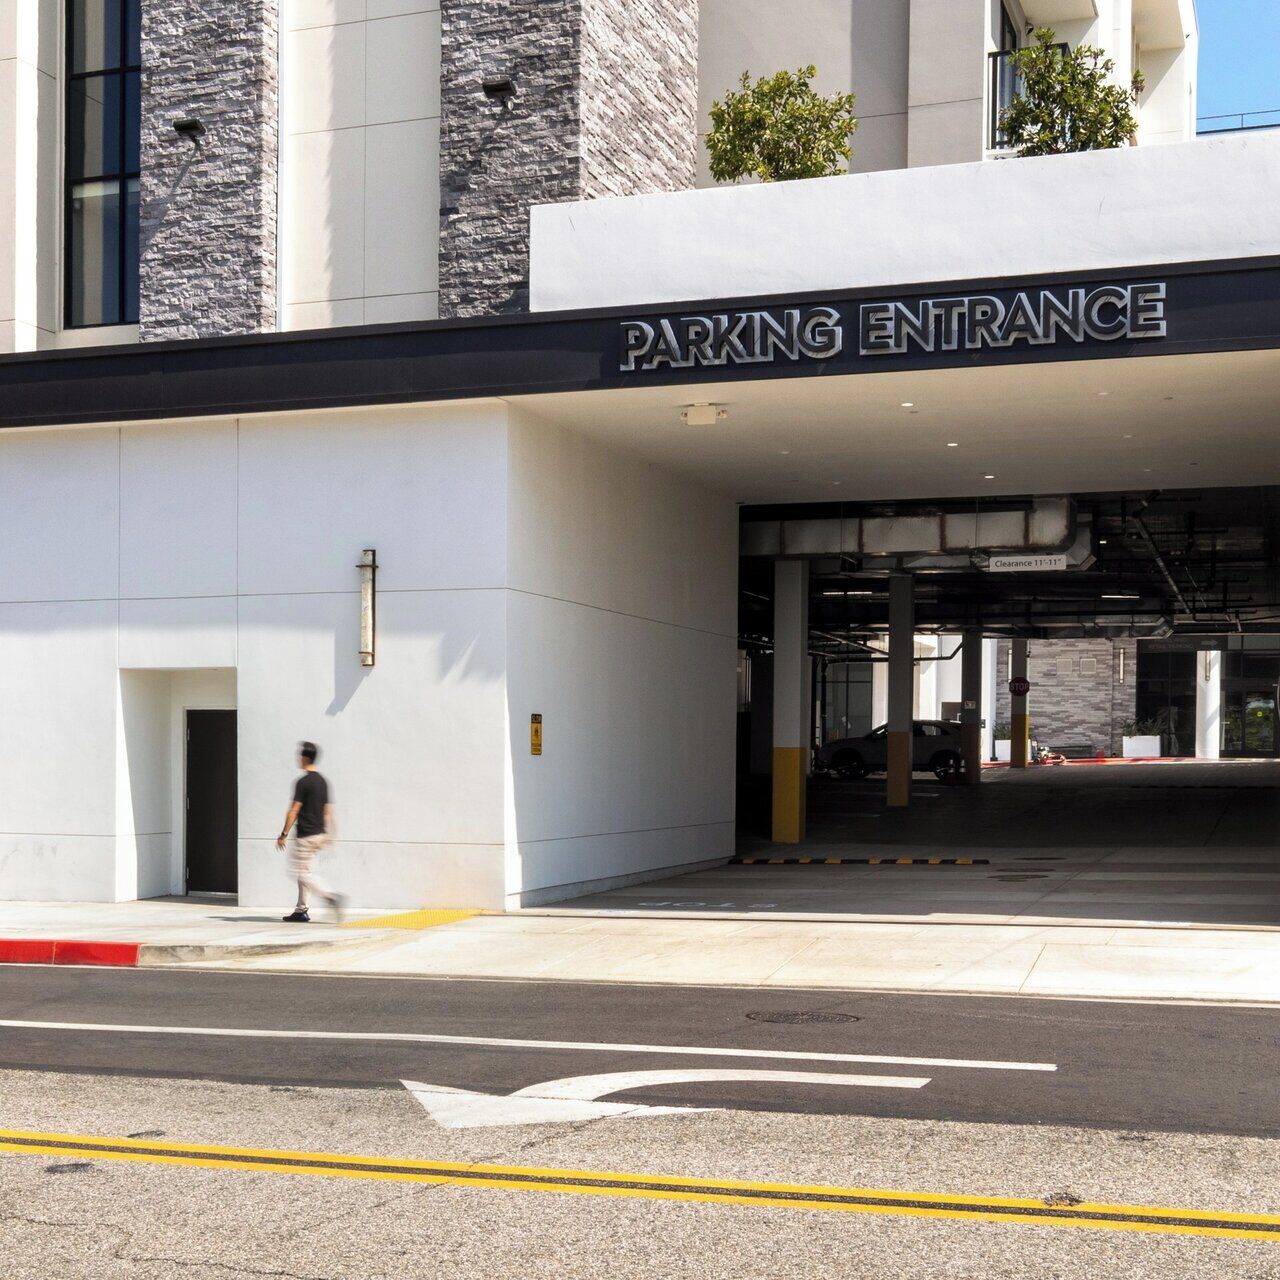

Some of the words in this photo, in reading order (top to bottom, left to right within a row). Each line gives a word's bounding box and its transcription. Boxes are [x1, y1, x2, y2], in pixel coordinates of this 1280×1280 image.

[620, 306, 843, 371] PARKING
[859, 282, 1166, 355] ENTRANCE
[995, 560, 1032, 568] Clearance
[1009, 682, 1029, 691] STOP
